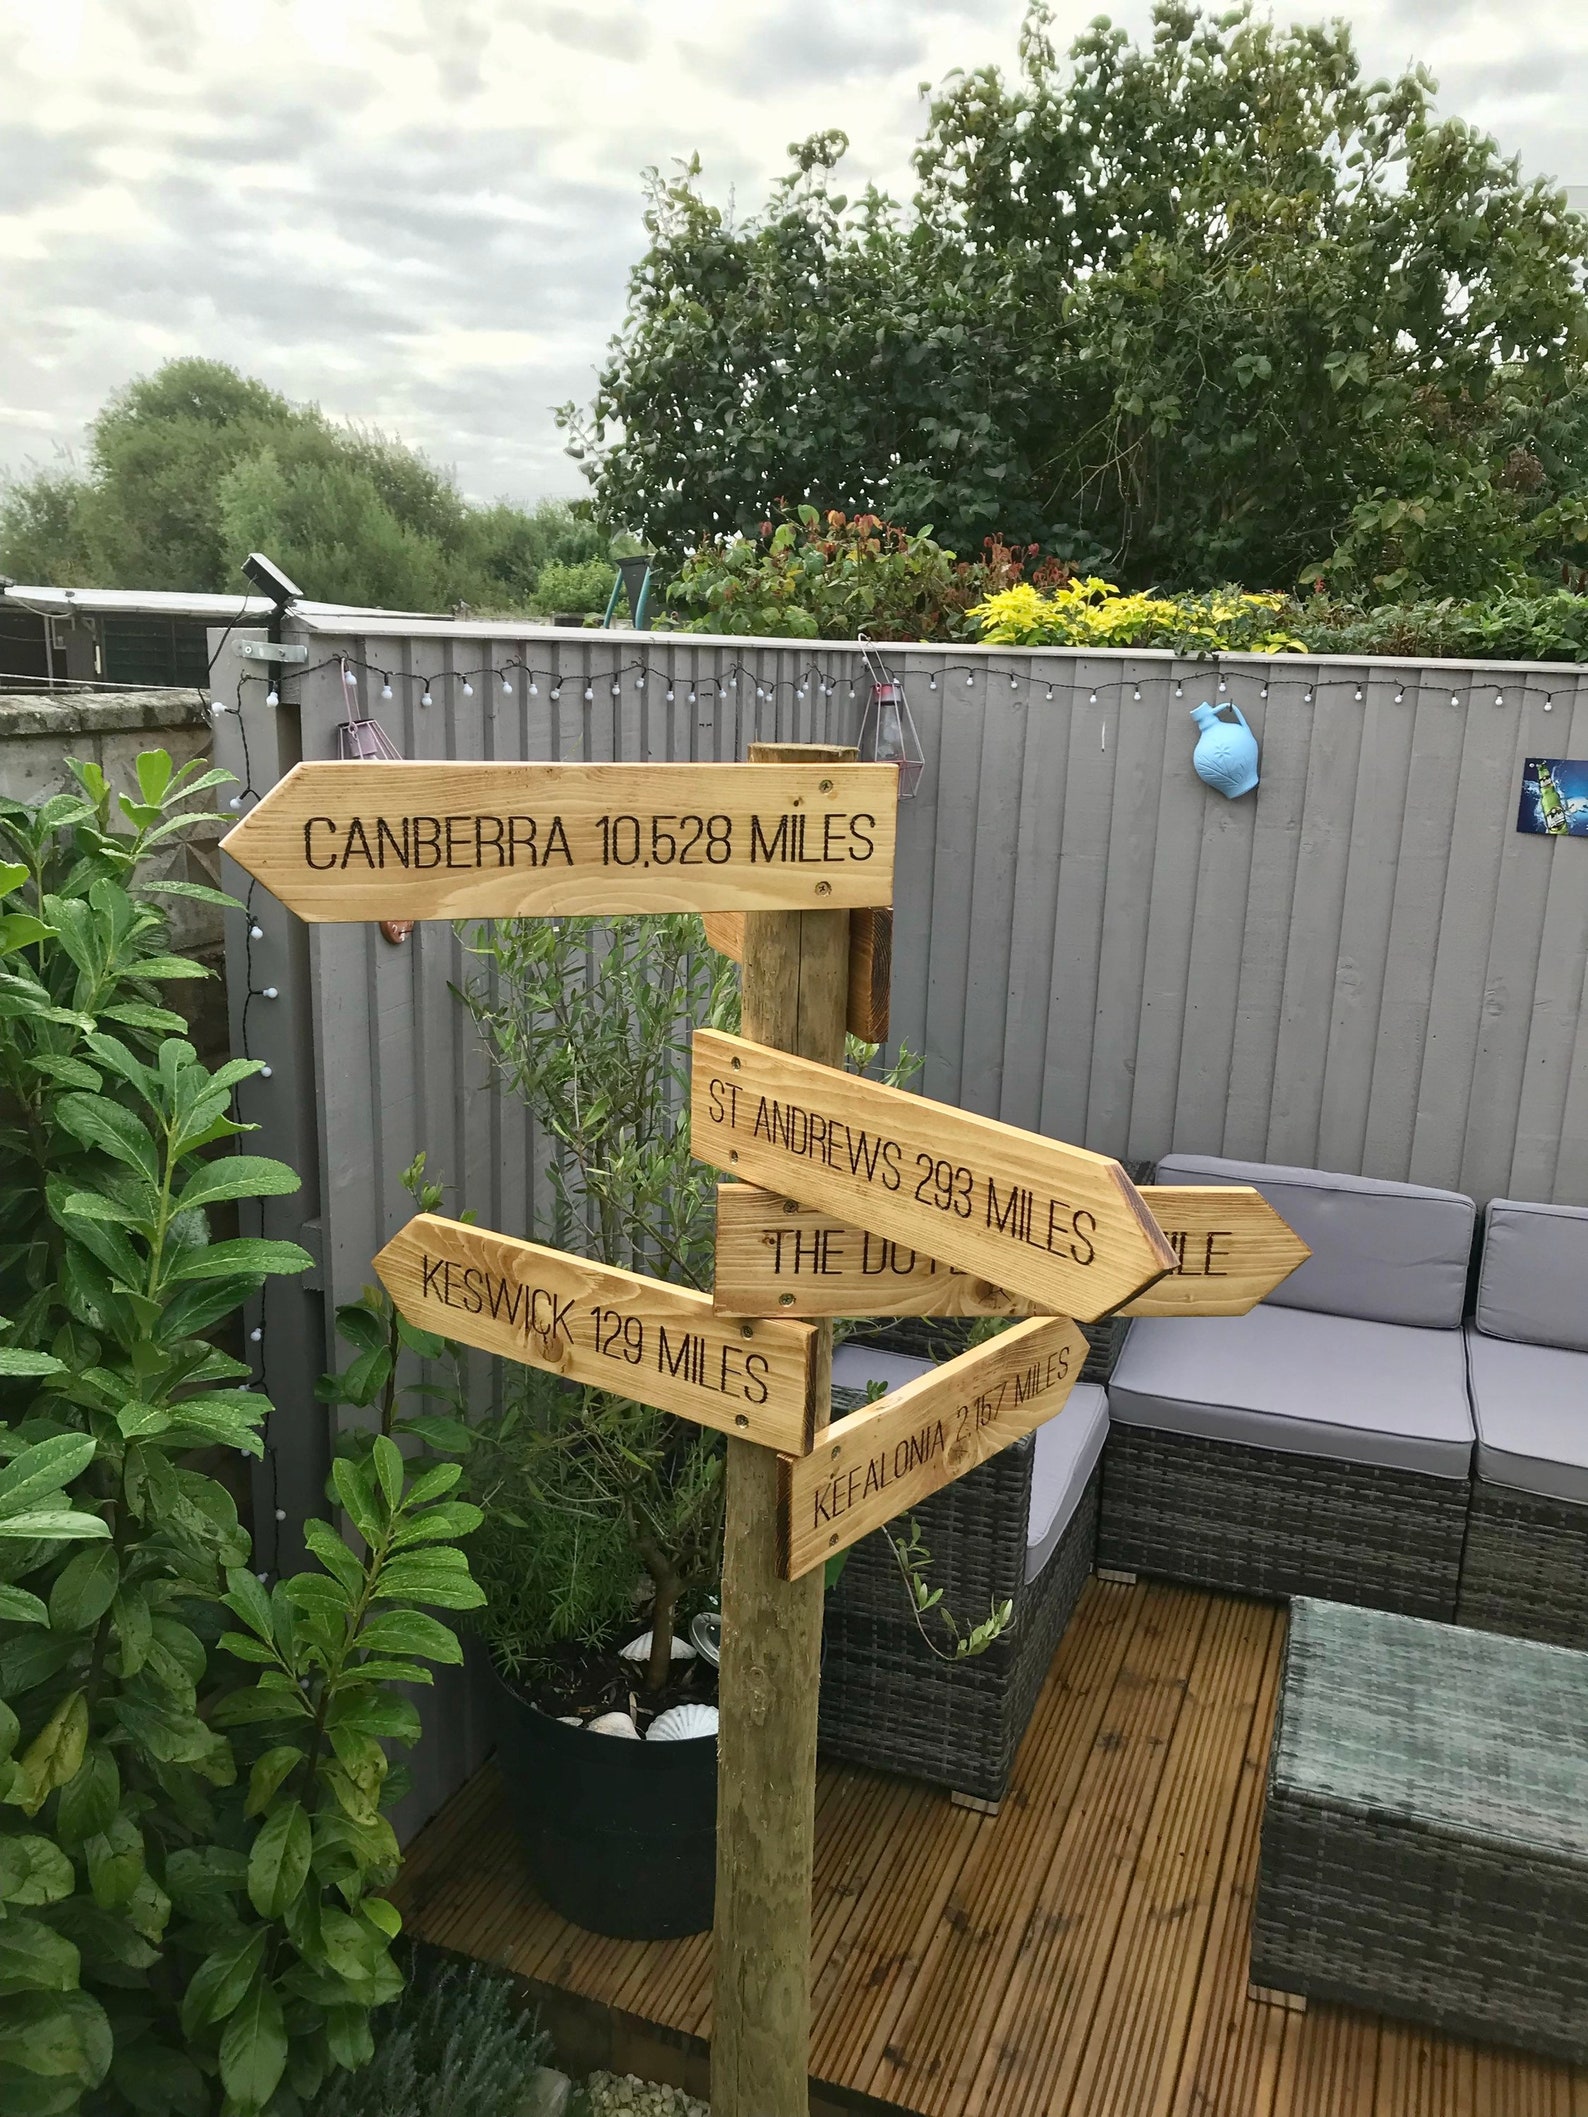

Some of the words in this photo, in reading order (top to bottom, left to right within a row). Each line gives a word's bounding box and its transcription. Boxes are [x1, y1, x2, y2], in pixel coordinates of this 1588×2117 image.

[304, 817, 574, 870] CANBERRA
[595, 814, 733, 868] 10,528
[751, 812, 875, 863] MILES
[708, 1078, 743, 1129] ST
[753, 1096, 902, 1191] ANDREWS
[914, 1153, 973, 1218] 293
[986, 1177, 1096, 1266] MILES
[762, 1229, 845, 1274] THE
[1162, 1231, 1233, 1275] ILE
[421, 1254, 575, 1345] KESWICK
[589, 1306, 643, 1364] 129
[657, 1325, 769, 1404] MILES
[812, 1419, 946, 1529] KEFALONIA
[1014, 1346, 1070, 1408] MILES
